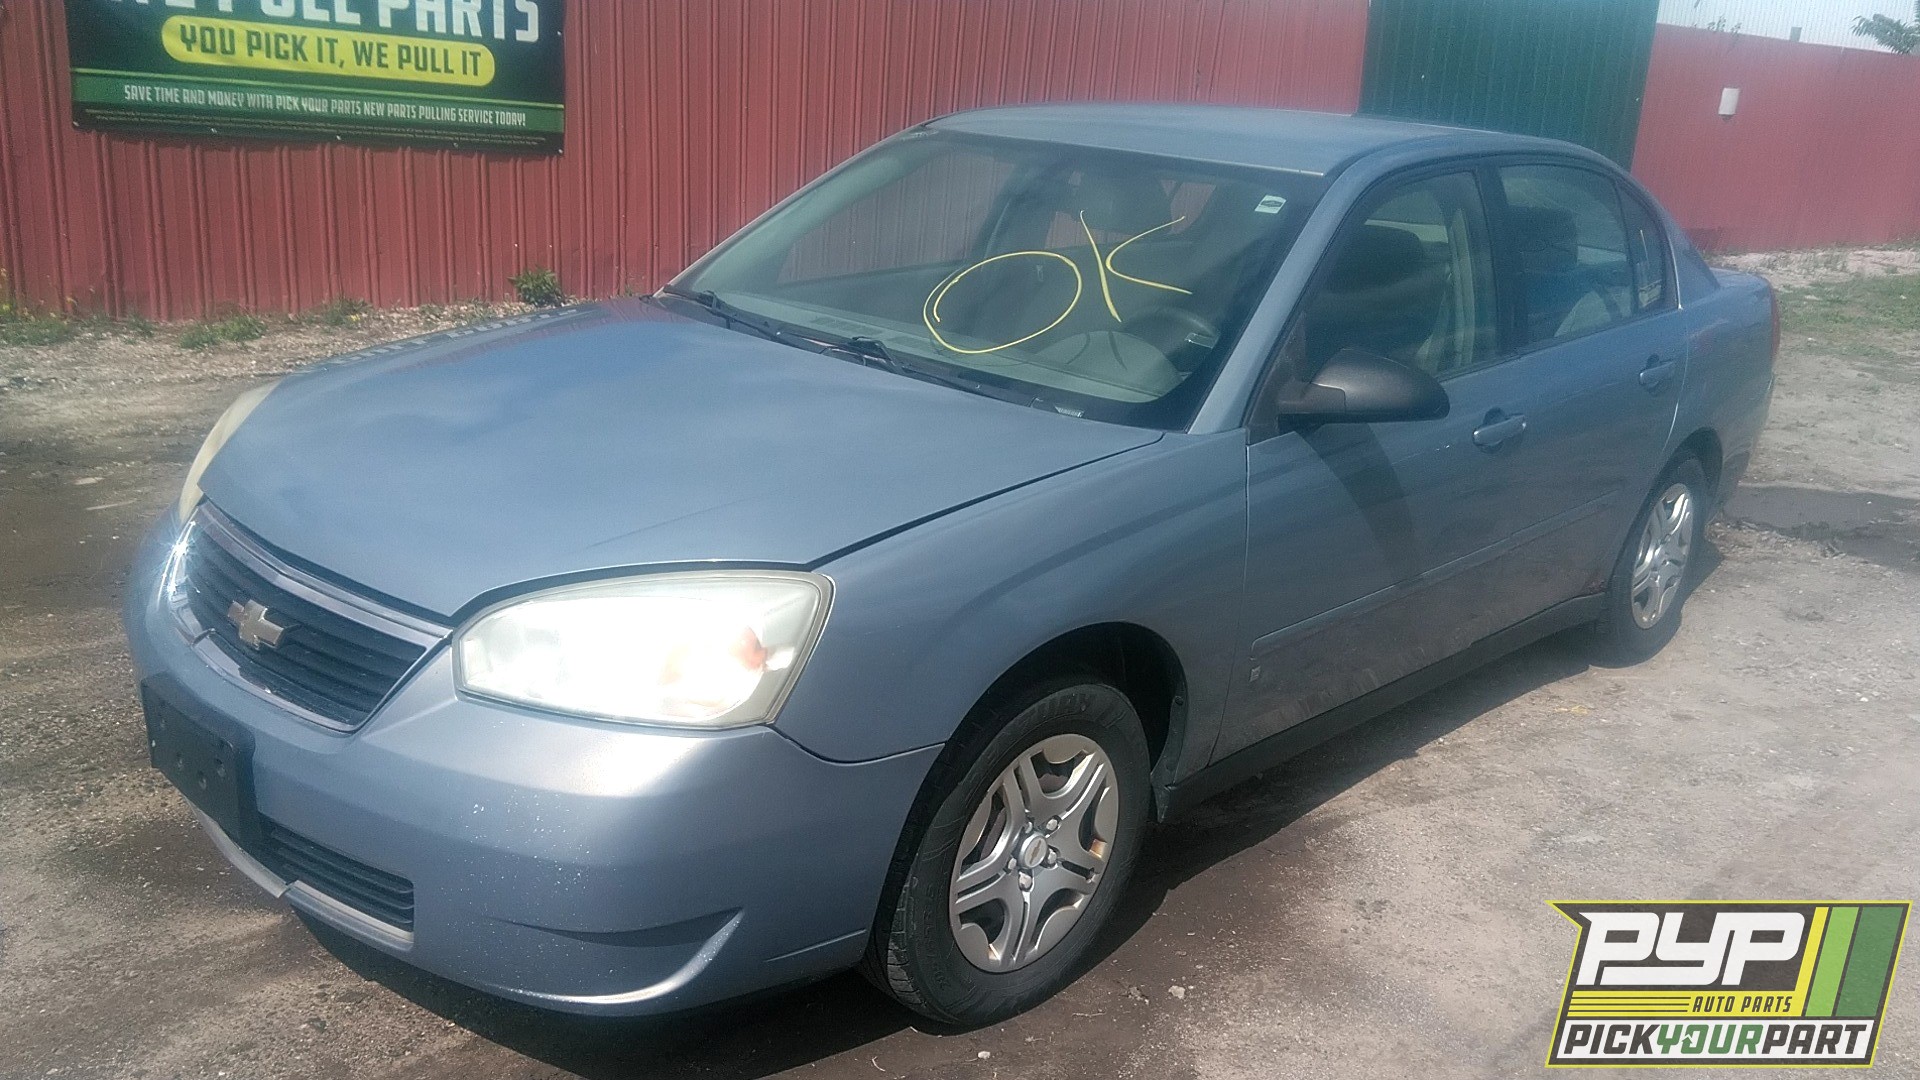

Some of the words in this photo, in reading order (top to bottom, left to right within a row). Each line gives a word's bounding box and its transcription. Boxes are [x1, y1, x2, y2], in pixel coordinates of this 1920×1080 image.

[180, 24, 235, 55] YOU
[246, 30, 308, 62] PICK
[316, 36, 345, 69] IT,
[352, 40, 389, 69] WE
[398, 44, 455, 73] PULL
[461, 50, 481, 76] IT
[124, 84, 152, 101] SAVE
[154, 86, 180, 103] TIME
[183, 88, 205, 105] AND
[207, 90, 244, 108] MONEY
[247, 93, 273, 110] WITH
[275, 94, 301, 111] PICK
[301, 97, 329, 113] YOUR
[331, 99, 361, 115] PARTS
[364, 101, 385, 117] NEW
[387, 102, 416, 119] PARTS
[419, 104, 457, 122] PULLING
[458, 107, 493, 124] SERVICE
[495, 110, 526, 127] TODAY!
[923, 210, 1193, 354] OK
